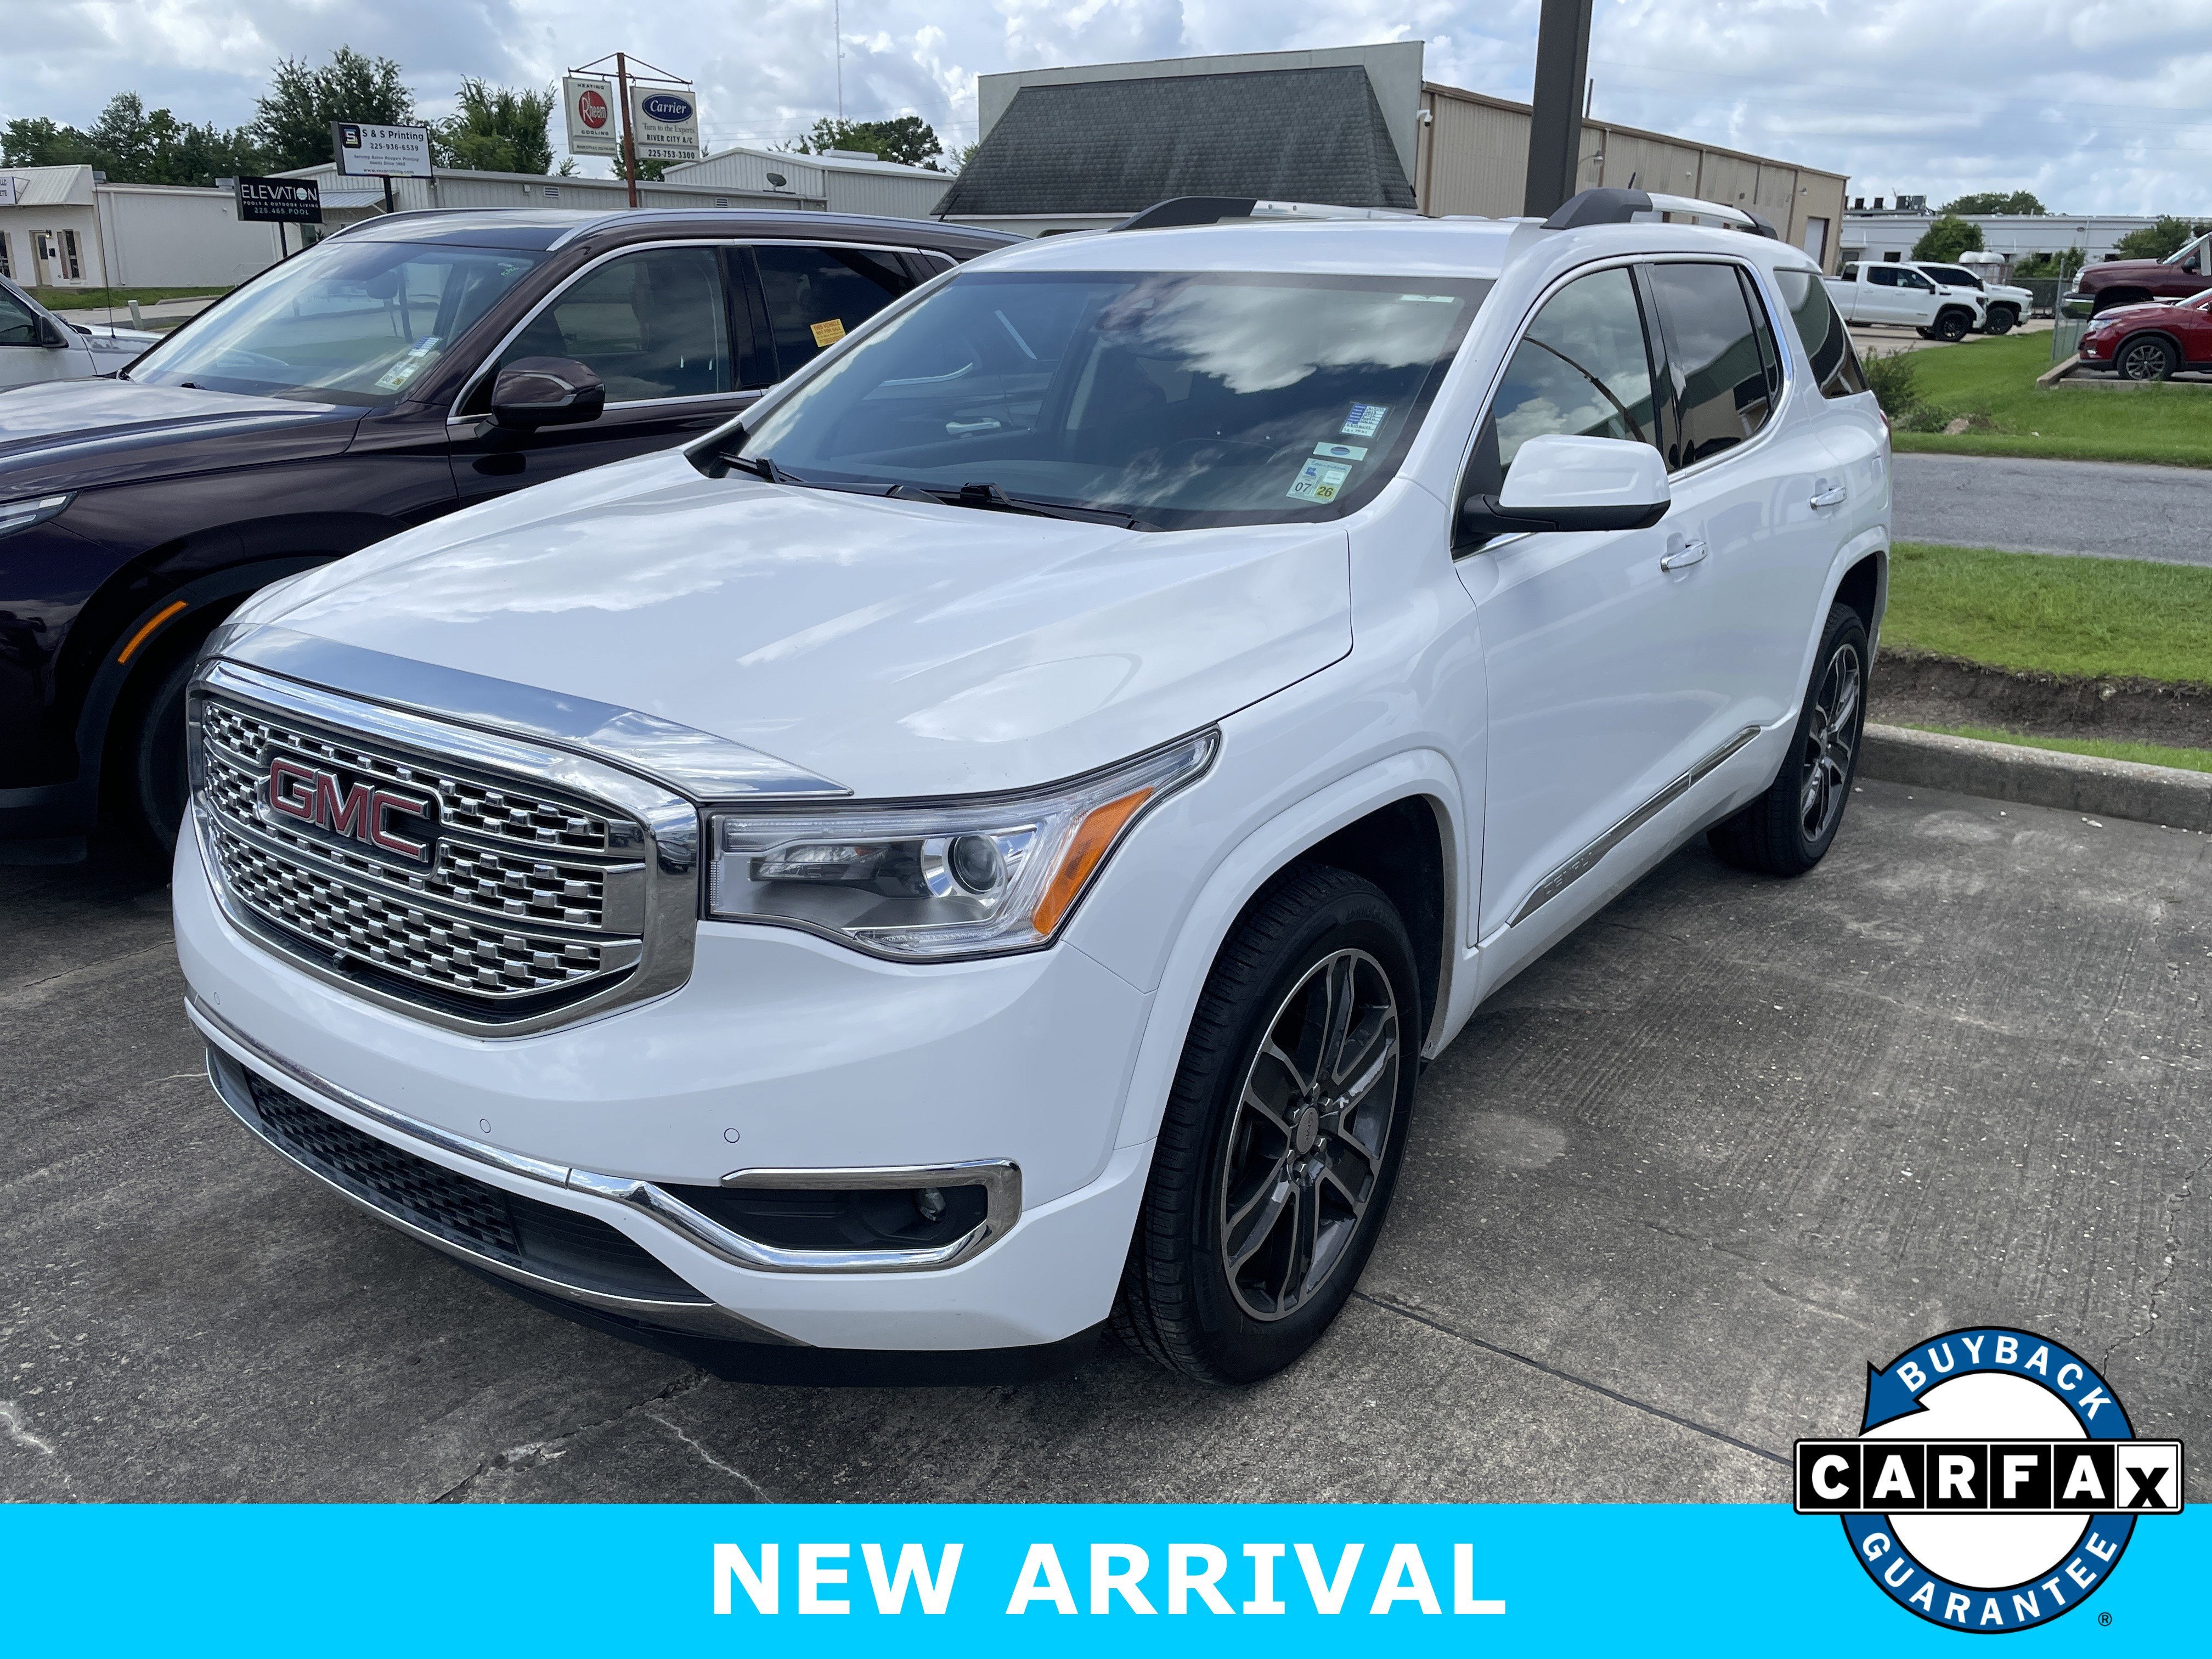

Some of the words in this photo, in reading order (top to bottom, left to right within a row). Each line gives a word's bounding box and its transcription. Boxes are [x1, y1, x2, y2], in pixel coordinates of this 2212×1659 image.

[582, 91, 606, 123] Rheem
[650, 100, 687, 114] Carrier
[642, 122, 656, 131] Turn
[388, 131, 424, 142] Printing
[370, 143, 419, 151] 225-936-6539
[648, 149, 695, 159] 225-753-3300
[241, 184, 318, 201] ELEVATION
[1295, 482, 1312, 492] 07
[1317, 486, 1334, 497] 26
[270, 757, 430, 862] GMC
